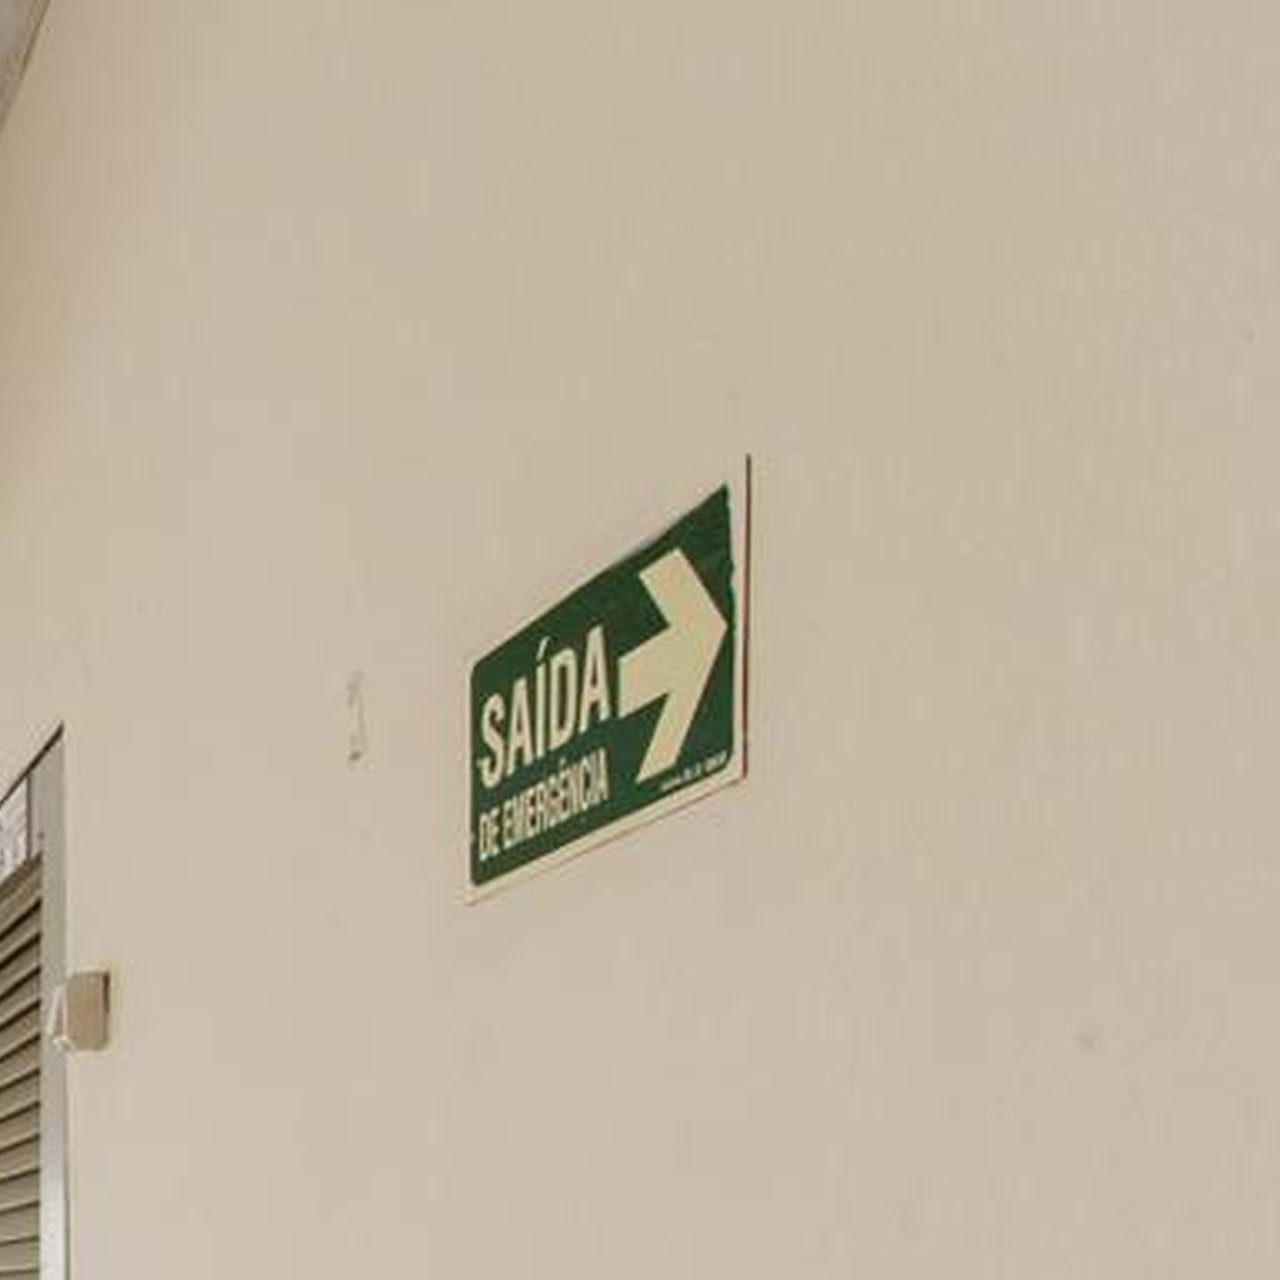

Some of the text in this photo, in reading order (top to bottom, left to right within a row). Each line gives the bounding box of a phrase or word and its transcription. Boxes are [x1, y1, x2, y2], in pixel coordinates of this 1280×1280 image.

[477, 624, 611, 789] SAÍDA
[479, 808, 501, 862] DE
[503, 747, 609, 850] EMERGÊNCIA
